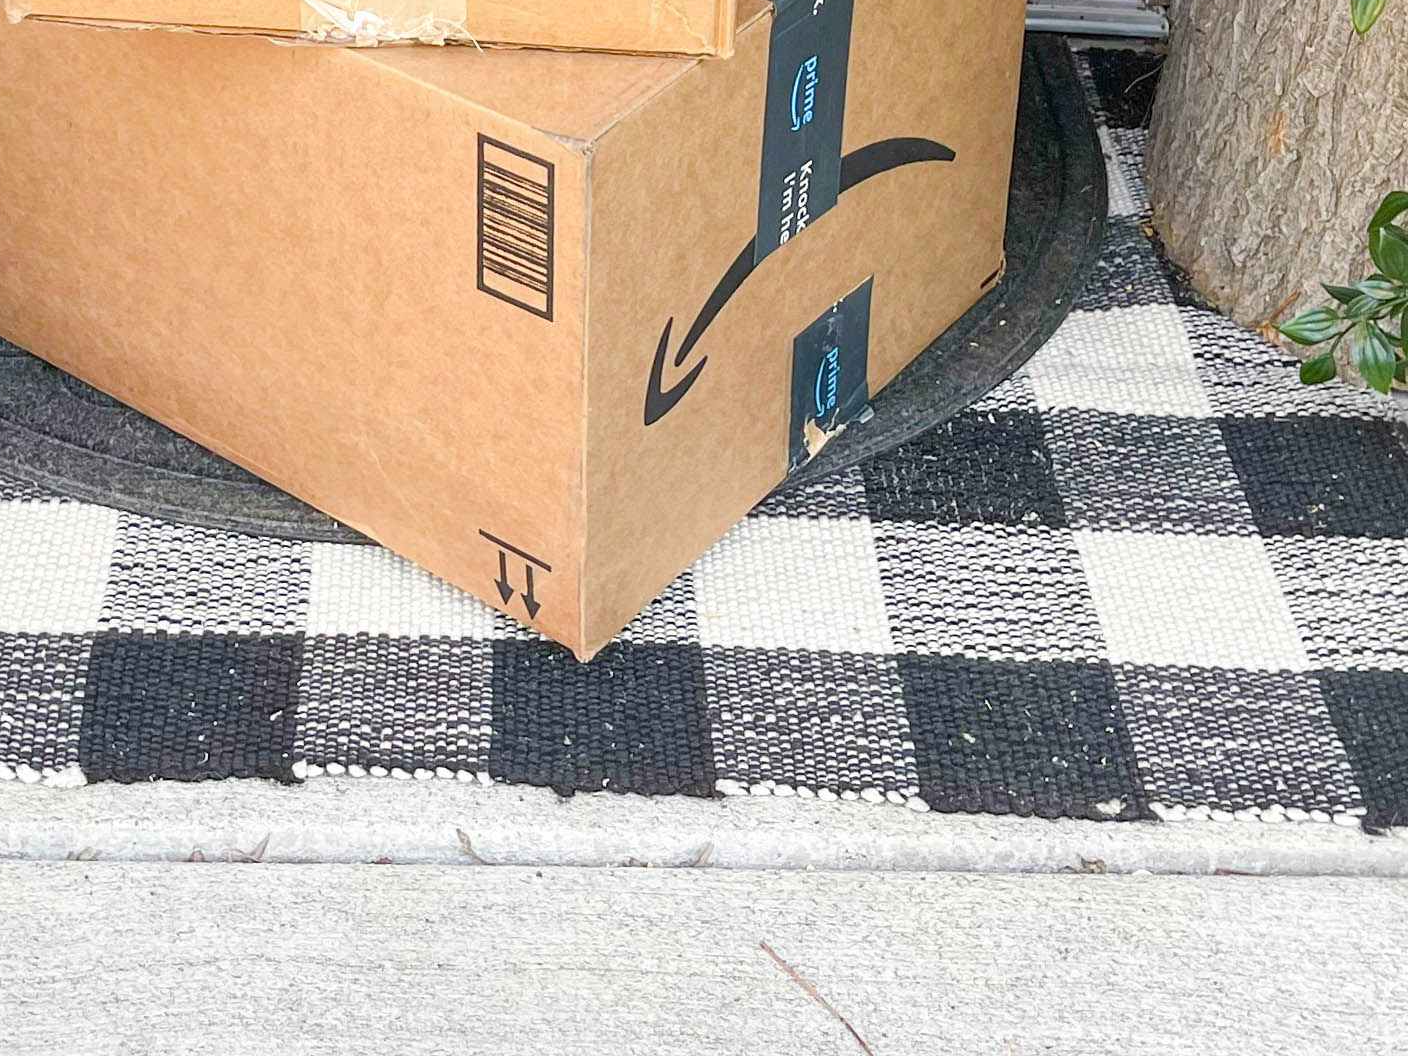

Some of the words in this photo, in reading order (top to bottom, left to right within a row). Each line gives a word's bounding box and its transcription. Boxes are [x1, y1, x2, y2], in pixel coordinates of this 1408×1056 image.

[802, 55, 818, 125] prime
[782, 172, 796, 212] I'm
[795, 159, 813, 235] Knock
[779, 212, 795, 245] he
[826, 346, 840, 410] prime
